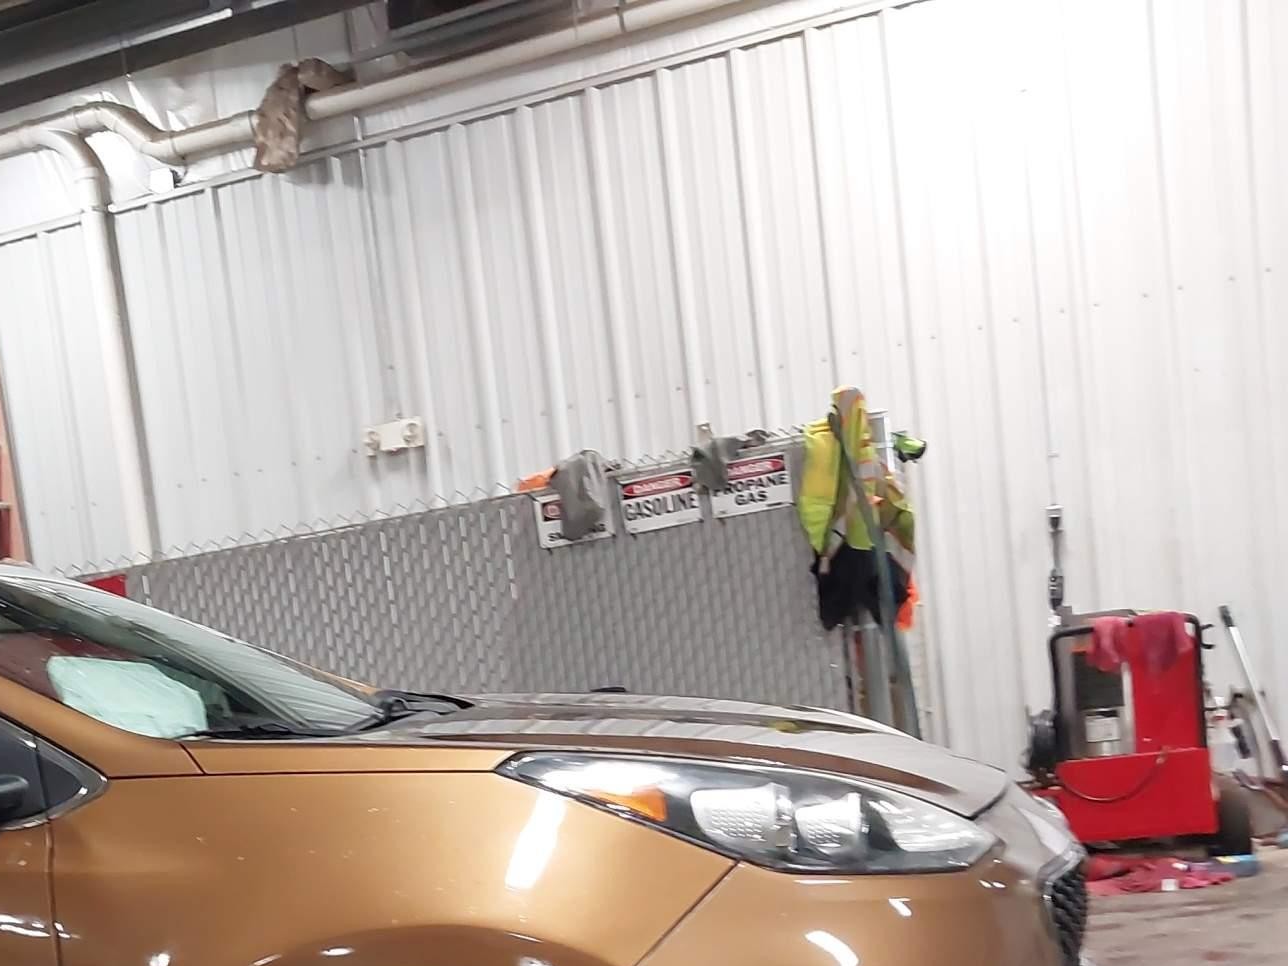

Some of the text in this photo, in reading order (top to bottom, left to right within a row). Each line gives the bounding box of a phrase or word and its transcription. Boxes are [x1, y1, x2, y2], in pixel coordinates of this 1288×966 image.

[632, 477, 681, 494] DANGER
[624, 491, 699, 521] GASOLINE
[734, 490, 768, 506] GAS
